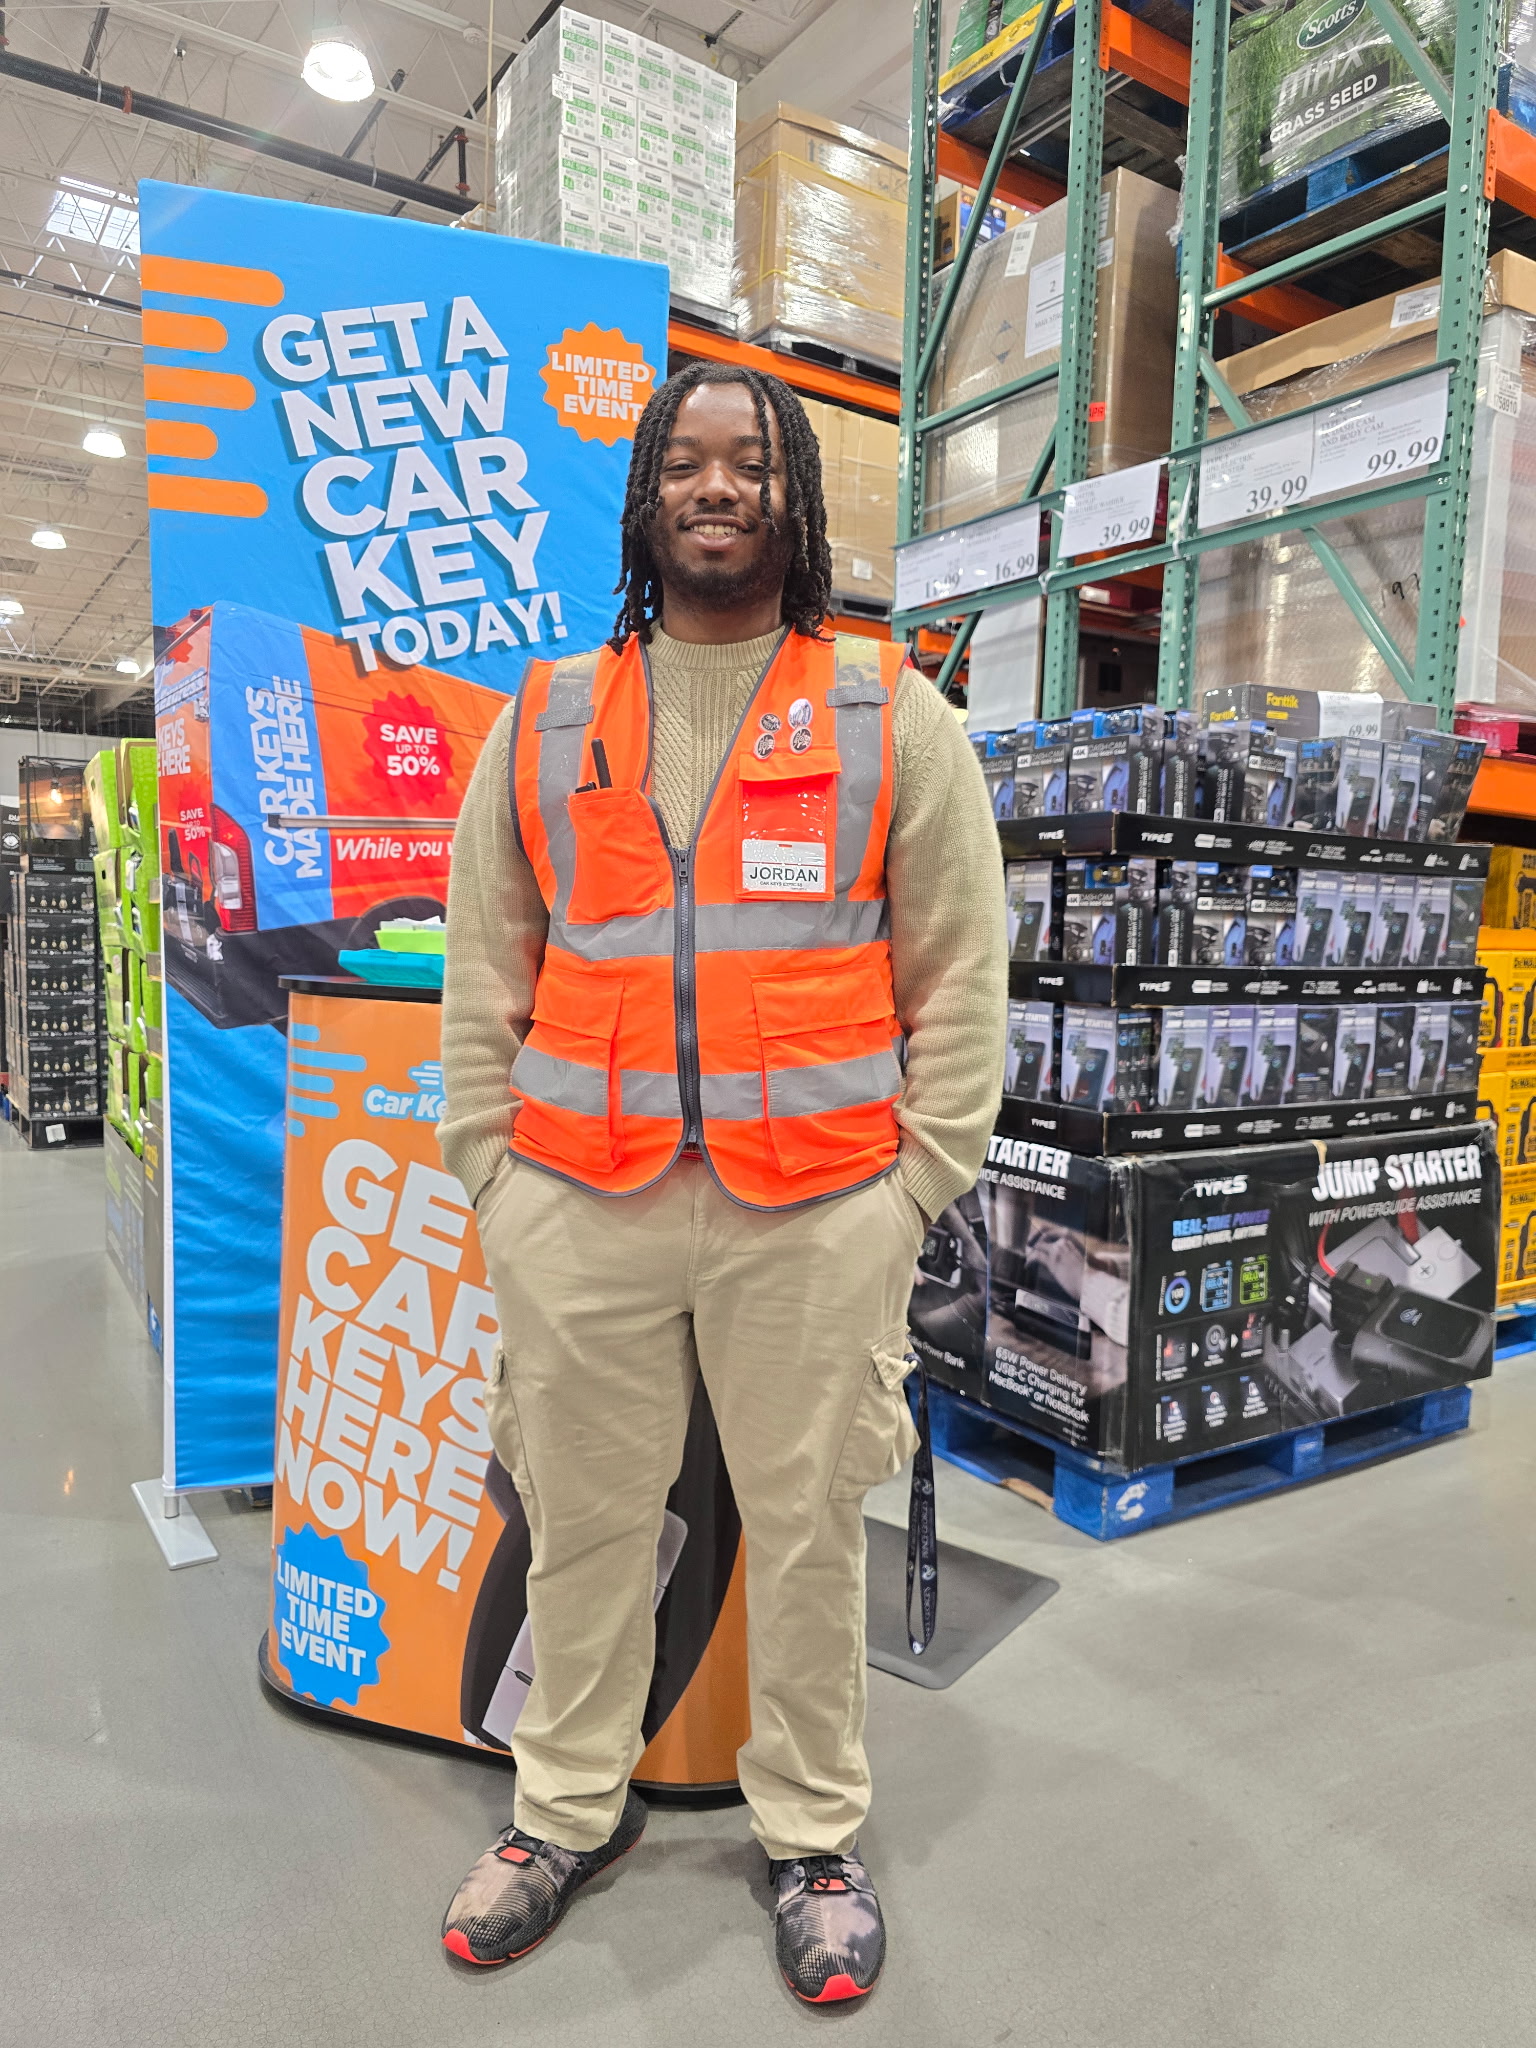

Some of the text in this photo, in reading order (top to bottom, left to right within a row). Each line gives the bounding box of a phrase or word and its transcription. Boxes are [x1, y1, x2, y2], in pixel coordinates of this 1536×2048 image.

[1305, 1, 1357, 42] Scotts
[1270, 74, 1378, 143] GRASS SEED
[261, 296, 510, 382] GET A
[551, 351, 650, 383] LIMITED
[563, 394, 643, 421] EVENT
[574, 375, 633, 401] TIME
[280, 364, 509, 457] NEW
[1365, 436, 1438, 479] 99.99
[301, 436, 540, 536] CAR
[1246, 475, 1307, 513] 39.99
[1099, 517, 1150, 547] 39.99
[324, 511, 550, 620] KEY
[995, 553, 1035, 582] 16.99
[341, 591, 568, 672] TODAY!
[1266, 692, 1299, 709] Fanttik
[158, 718, 185, 750] KEYS
[380, 724, 438, 744] SAVE
[395, 744, 430, 755] UP TO
[1349, 723, 1378, 737] 69.99
[160, 745, 192, 777] HERE
[245, 686, 295, 866] CAR KEYS
[272, 676, 323, 879] MADE HERE
[387, 755, 440, 776] 50%
[180, 808, 205, 822] SAVE
[184, 826, 206, 842] 50%
[336, 837, 401, 860] While
[407, 842, 443, 865] you
[750, 866, 818, 882] JORDAN
[1085, 1019, 1113, 1029] STARTER
[366, 1089, 414, 1115] Car
[1000, 1173, 1067, 1200] ASSISTANCE
[1312, 1144, 1482, 1201] JUMP STARTER
[322, 1139, 494, 1288] GE
[1309, 1188, 1482, 1227] WITH POWERGUIDE ASSISTANCE
[306, 1225, 502, 1380] CAR
[290, 1293, 495, 1452] KEYS
[995, 1346, 1088, 1397] 65W Power Delivery
[995, 1359, 1085, 1407] USB-C Charging for
[1034, 1391, 1045, 1402] or
[1045, 1394, 1090, 1424] Notebook
[282, 1354, 490, 1528] HERE
[276, 1418, 474, 1593] NOW!
[277, 1554, 377, 1618] LIMITED
[286, 1592, 350, 1642] TIME
[281, 1618, 366, 1676] EVENT
